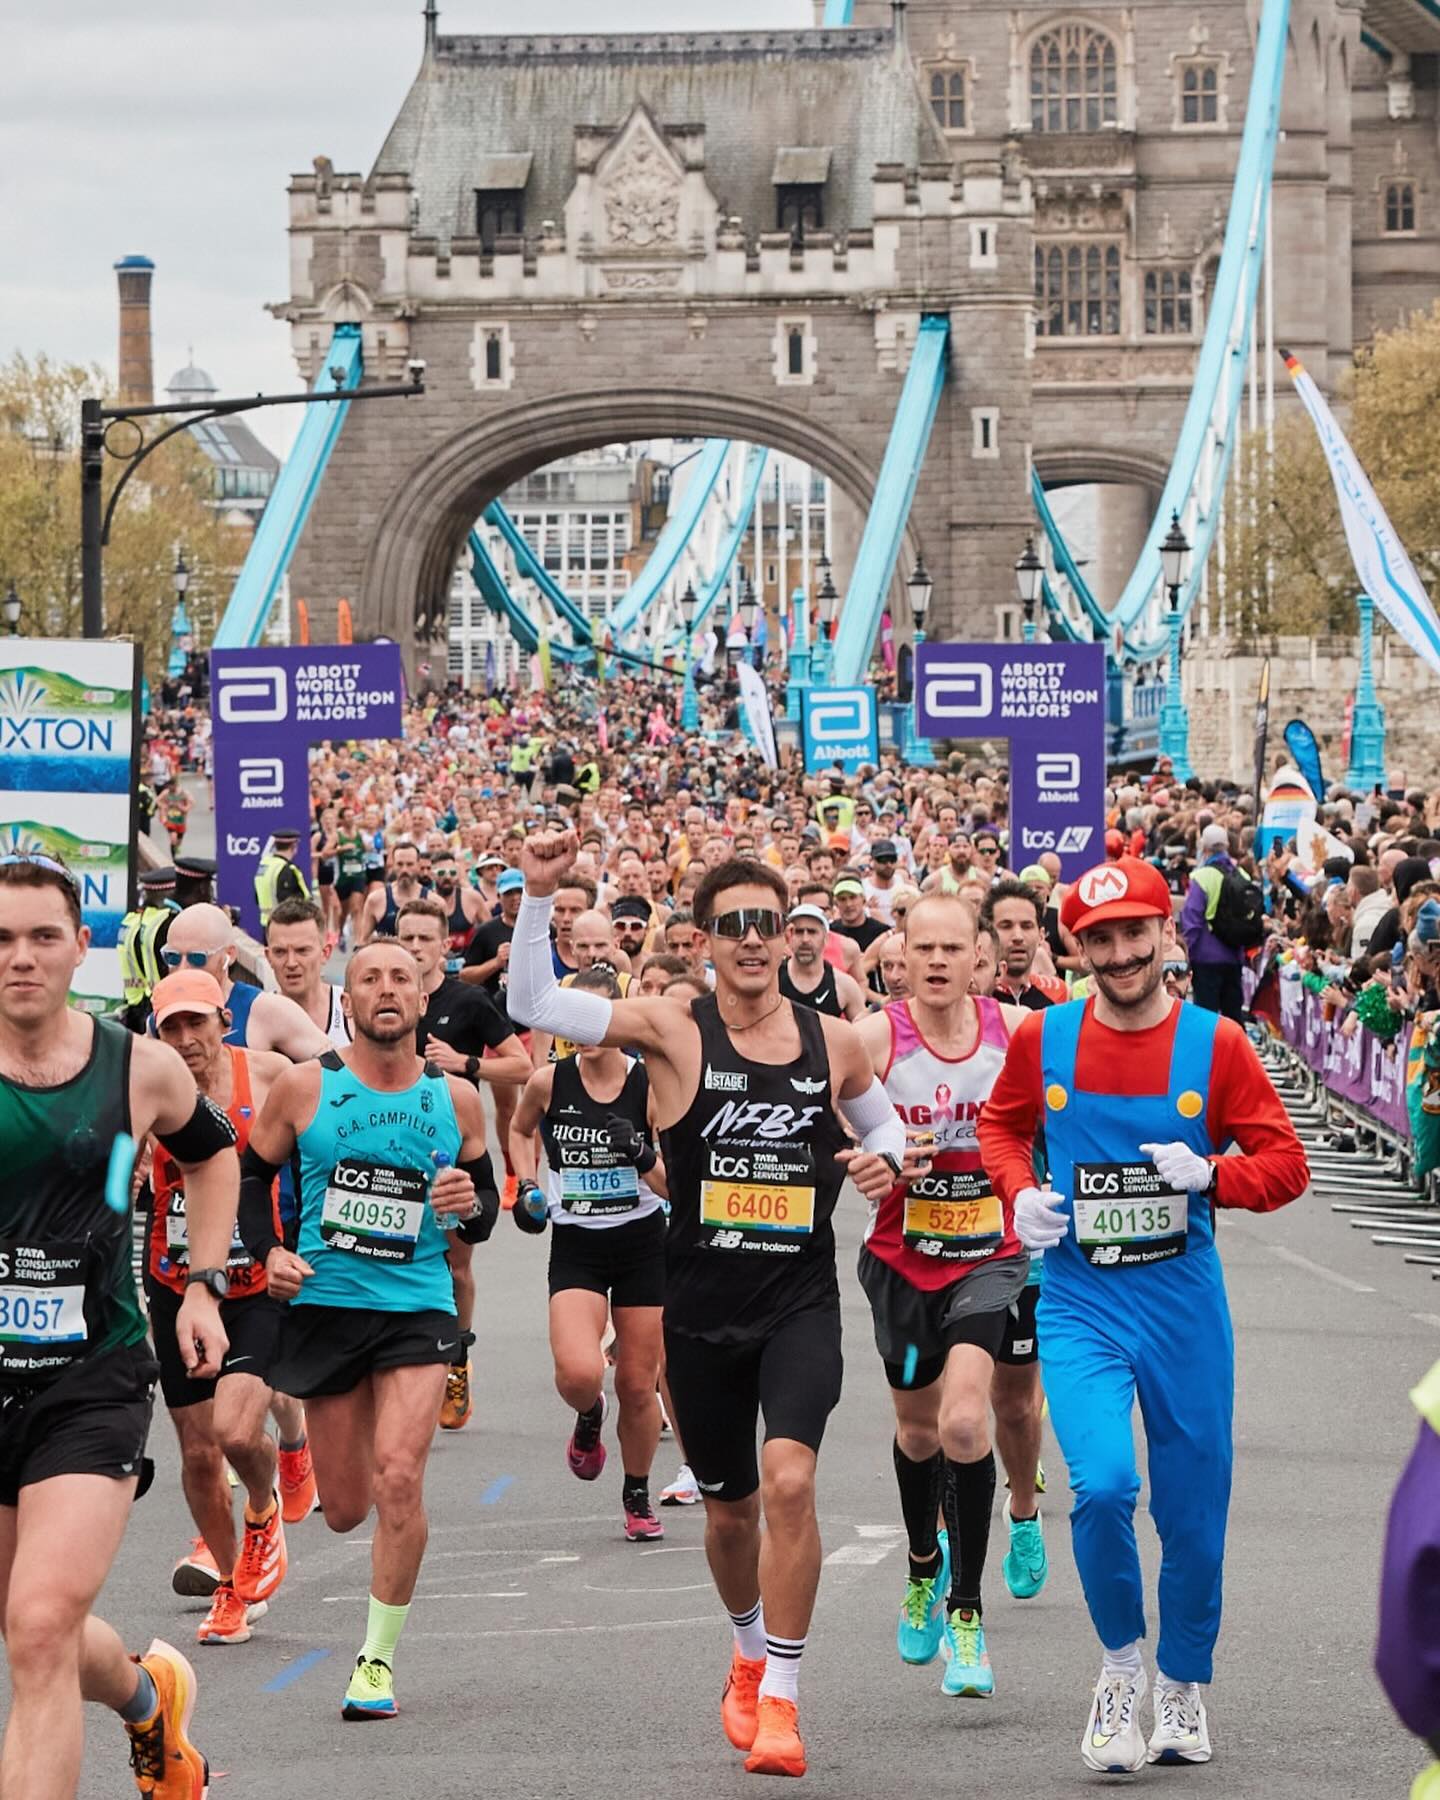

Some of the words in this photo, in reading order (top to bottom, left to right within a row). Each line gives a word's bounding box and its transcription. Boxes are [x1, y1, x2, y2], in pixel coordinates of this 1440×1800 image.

[295, 664, 362, 679] ABBOTT
[1001, 662, 1066, 676] ABBOTT
[295, 678, 356, 692] WORLD
[1001, 676, 1060, 690] WORLD
[296, 691, 395, 706] MARATHON
[1001, 690, 1098, 703] MARATHON
[296, 706, 367, 721] MAJORS
[1001, 703, 1071, 718] MAJORS
[0, 716, 112, 752] XTON
[813, 744, 870, 760] Abbott
[241, 796, 284, 809] Abbott
[1037, 790, 1080, 803] Abbott
[226, 833, 260, 855] tcs
[1022, 826, 1055, 849] tcs
[1087, 870, 1125, 901] M
[713, 1074, 743, 1089] STAGE
[337, 1119, 365, 1138] C.A.
[369, 1111, 437, 1138] CAMPILLO
[561, 1146, 590, 1165] tcs
[591, 1146, 609, 1154] TATA
[710, 1150, 750, 1178] tcs
[753, 1153, 778, 1163] TATA
[374, 1168, 395, 1179] TATA
[752, 1162, 809, 1174] CONSULTANCY
[1122, 1166, 1148, 1176] TATA
[334, 1163, 370, 1189] tcs
[371, 1176, 422, 1190] CONSULTANCY
[578, 1171, 621, 1192] 1876
[752, 1171, 789, 1181] SERVICES
[952, 1175, 975, 1183] TATA
[1079, 1167, 1119, 1194] tcs
[370, 1183, 403, 1195] SERVICES
[951, 1188, 981, 1197] SERVICES
[1123, 1182, 1160, 1193] SERVICES
[727, 1191, 789, 1221] 6406
[338, 1199, 407, 1230] 40953
[929, 1207, 981, 1232] 5227
[1093, 1206, 1171, 1235] 40135
[15, 1247, 46, 1260] TATA
[354, 1244, 373, 1255] new
[373, 1247, 406, 1260] balance
[741, 1240, 761, 1251] new
[761, 1241, 801, 1253] balance
[942, 1250, 960, 1259] new
[960, 1248, 996, 1258] balance
[1121, 1253, 1141, 1263] new
[1142, 1247, 1179, 1261] balance
[15, 1258, 81, 1271] CONSULTANCY
[14, 1268, 57, 1281] SERVICES
[3, 1357, 28, 1368] new
[28, 1356, 73, 1369] balanc
